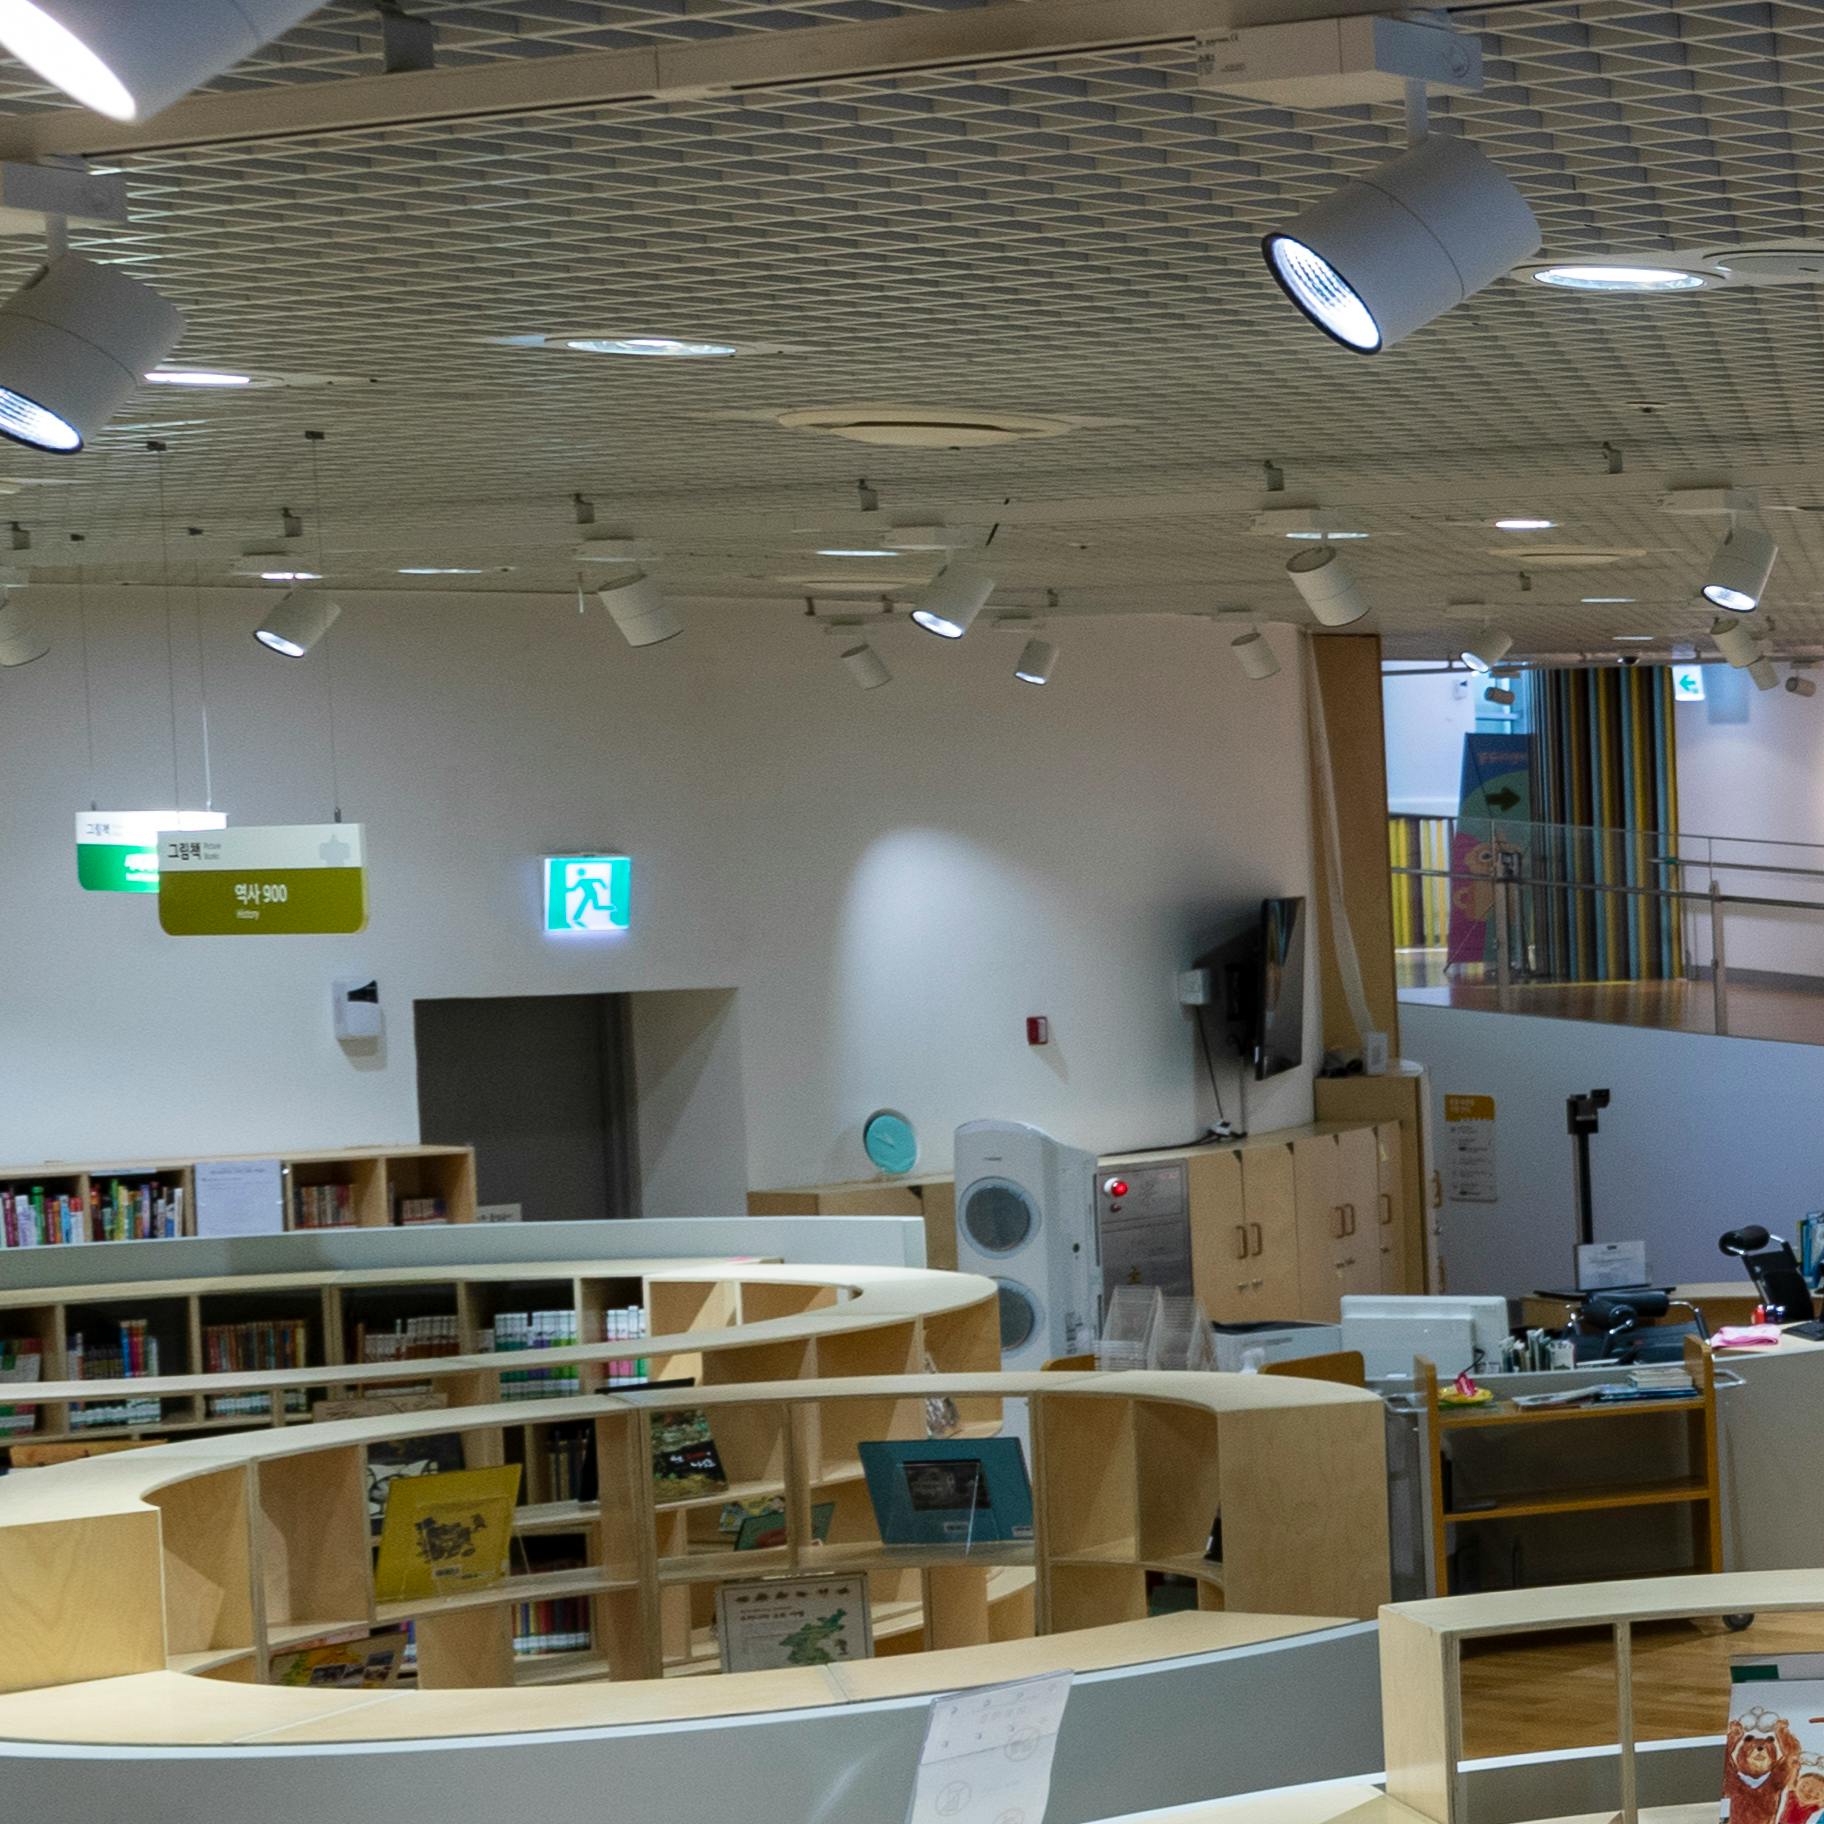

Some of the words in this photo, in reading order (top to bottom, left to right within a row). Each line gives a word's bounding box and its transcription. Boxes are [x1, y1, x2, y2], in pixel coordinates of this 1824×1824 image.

[168, 842, 201, 860] 그림책
[234, 883, 261, 905] 역사
[262, 884, 288, 903] 900
